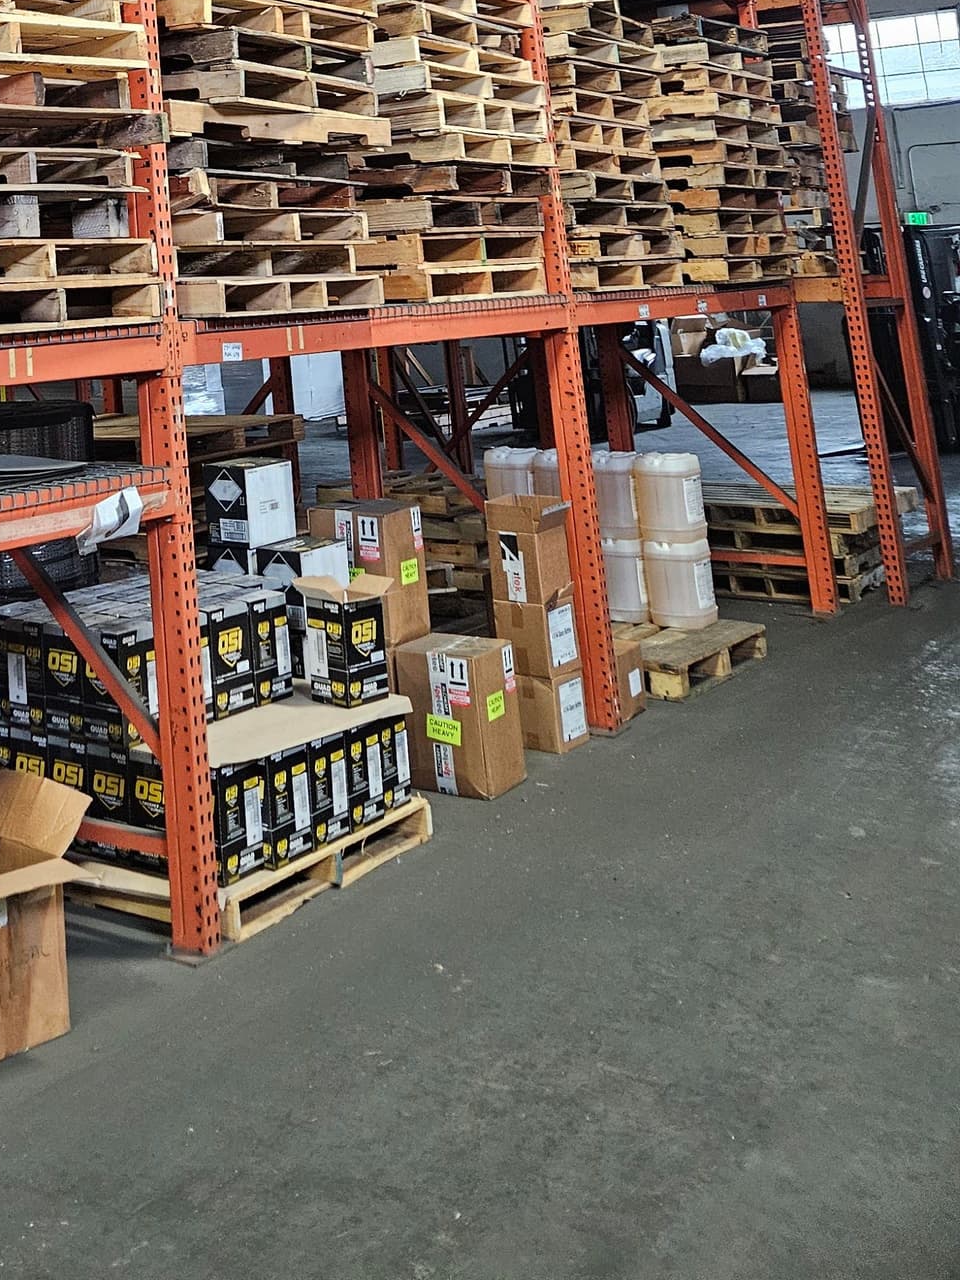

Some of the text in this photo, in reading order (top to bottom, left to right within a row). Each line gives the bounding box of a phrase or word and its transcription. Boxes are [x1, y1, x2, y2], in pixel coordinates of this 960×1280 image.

[218, 628, 243, 656] OSI
[352, 620, 377, 645] OSI
[48, 651, 78, 674] OSI
[52, 716, 69, 724] QUAD
[429, 718, 458, 731] CAUTION
[432, 726, 454, 738] HEAVY
[16, 756, 45, 777] OSI
[53, 762, 84, 787] OSI
[93, 773, 125, 798] OSI
